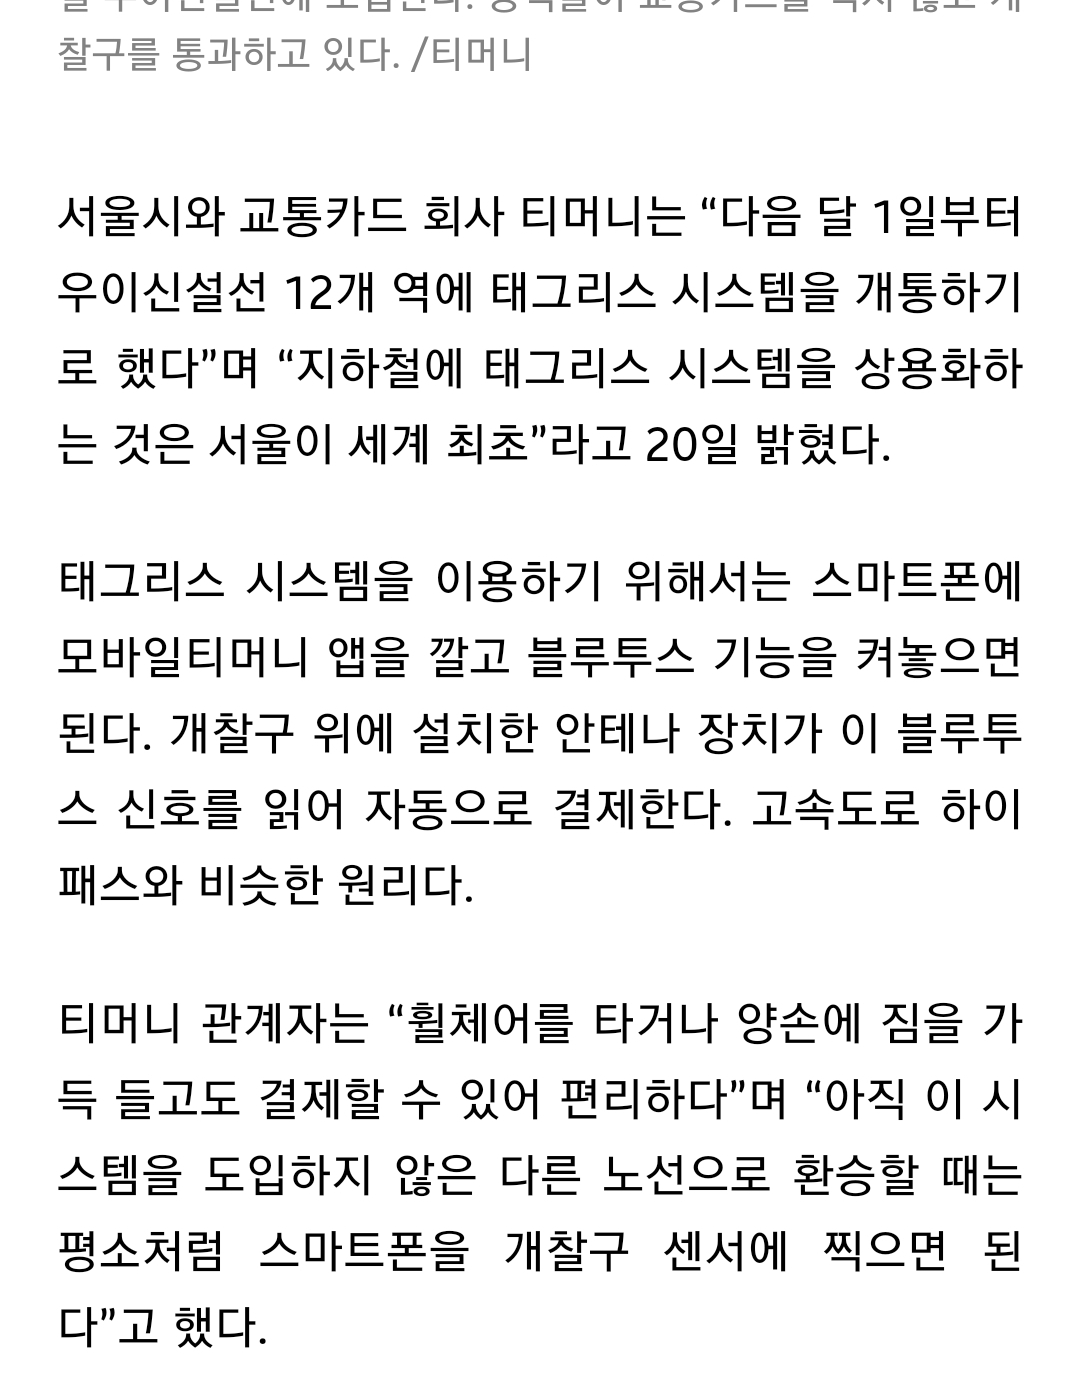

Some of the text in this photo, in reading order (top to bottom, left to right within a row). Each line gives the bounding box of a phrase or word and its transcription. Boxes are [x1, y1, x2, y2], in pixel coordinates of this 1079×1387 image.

[58, 35, 530, 73] 찰구를 통과하고 있다. /티머니
[57, 195, 226, 238] 서울시와
[239, 195, 407, 239] 교통카드
[423, 195, 506, 238] 회사
[522, 195, 686, 238] 티머니는
[819, 195, 857, 237] 달
[873, 195, 1019, 238] 1일부터
[57, 349, 98, 385] 로
[485, 347, 650, 390] 태그리스
[668, 347, 836, 390] 시스템을
[854, 347, 1024, 391] 상용화하
[57, 423, 98, 465] 는
[113, 423, 195, 466] 것은
[208, 423, 331, 466] 서울이
[347, 423, 428, 466] 세계
[646, 423, 737, 465] 20일
[756, 423, 890, 466] 밝혔다.
[60, 560, 1020, 604] 태그리스 시스템을 이용하기 위해서는 스마트폰에
[57, 636, 1020, 680] 모바일티머니 앱을 깔고 블루투스 기능을 켜놓으면
[57, 788, 1019, 832] 스 신호를 읽어 자동으로 결제한다. 고속도로 하이
[58, 864, 473, 907] 패스와 비슷한 원리다.
[61, 1002, 179, 1045] 티머니
[201, 1002, 369, 1045] 관계자는
[595, 1002, 719, 1045] 타거나
[738, 1002, 860, 1045] 양손에
[881, 1002, 964, 1044] 짐을
[983, 1002, 1024, 1045] 가
[57, 1079, 98, 1121] 득
[115, 1079, 241, 1121] 들고도
[259, 1078, 385, 1121] 결제할
[401, 1079, 441, 1121] 수
[460, 1078, 538, 1121] 있어
[926, 1078, 961, 1121] 이
[982, 1078, 1019, 1121] 시
[58, 1230, 1021, 1274] 평소처럼 스마트폰을 개찰구 센서에 찍으면 된
[174, 1306, 267, 1349] 했다.
